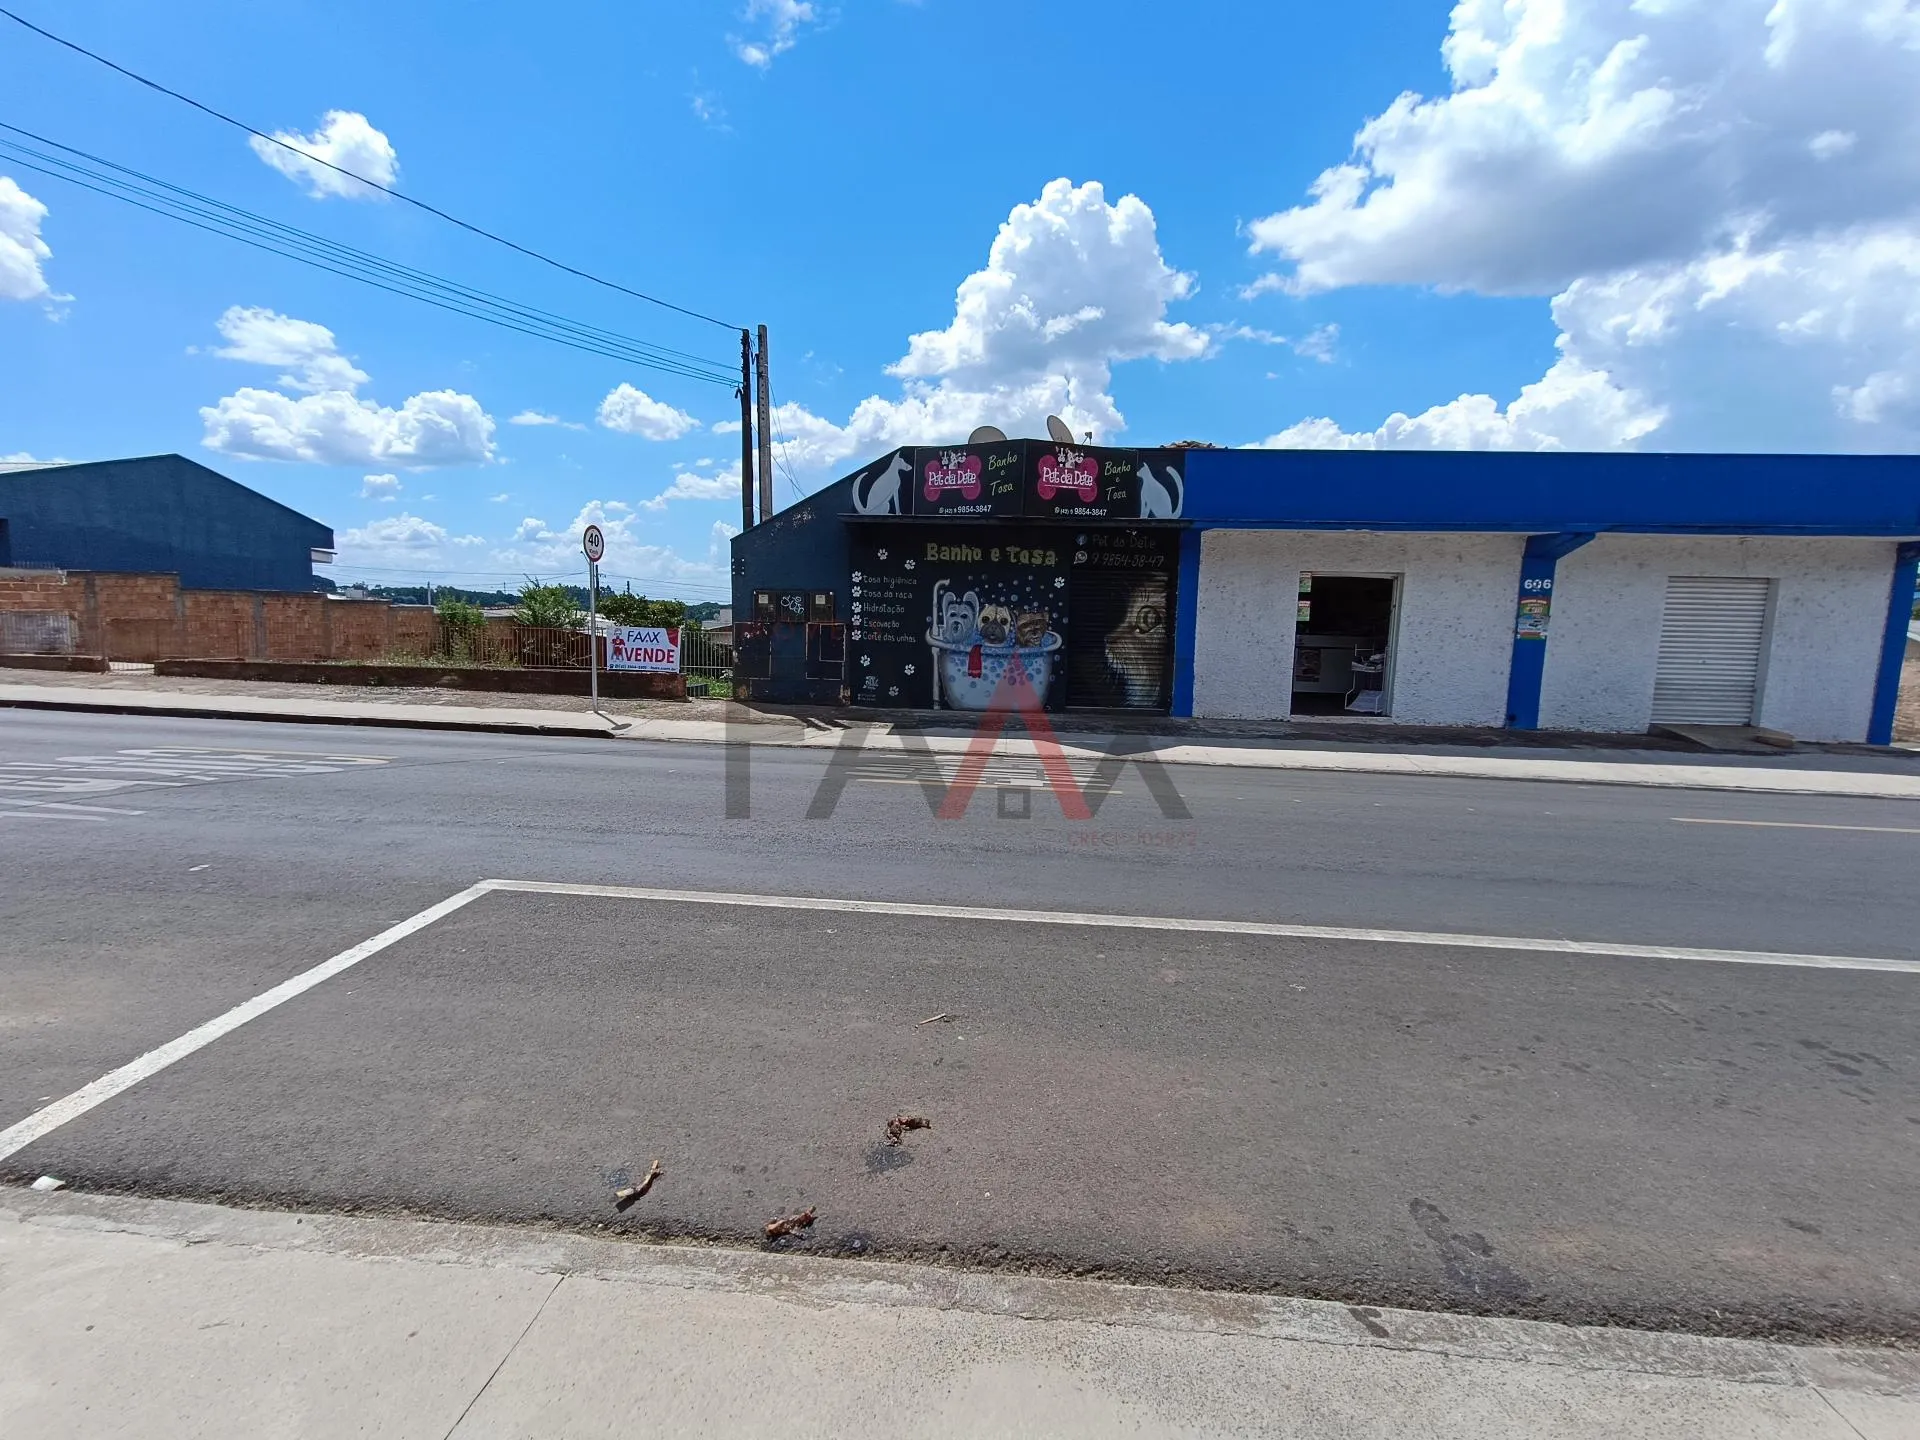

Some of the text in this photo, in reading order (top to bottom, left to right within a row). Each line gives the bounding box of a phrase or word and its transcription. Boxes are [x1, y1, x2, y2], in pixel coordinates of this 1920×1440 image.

[988, 451, 1018, 470] Banho
[1104, 460, 1131, 476] Banho
[928, 468, 977, 486] Pet da Dete
[1043, 466, 1093, 486] Pet da Dete
[989, 480, 1014, 496] Tosa
[1105, 487, 1127, 501] Tosa
[957, 505, 992, 514] 9854-3847
[1074, 507, 1107, 516] 9854-3847
[588, 533, 600, 547] 40
[926, 542, 1056, 565] Banho e Tosa
[627, 630, 661, 643] FAAX
[624, 647, 675, 664] VENDE
